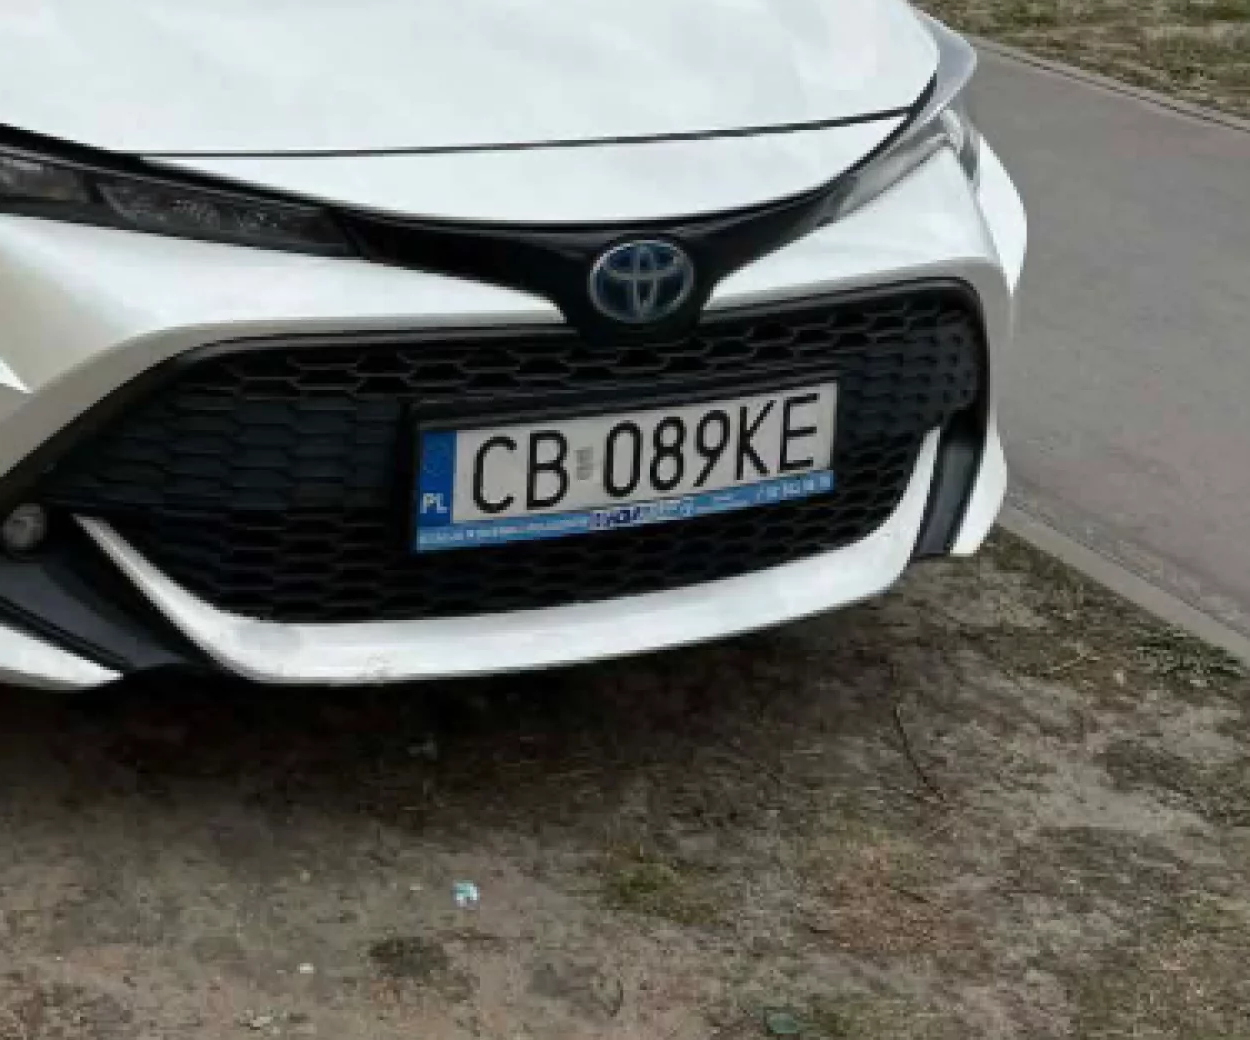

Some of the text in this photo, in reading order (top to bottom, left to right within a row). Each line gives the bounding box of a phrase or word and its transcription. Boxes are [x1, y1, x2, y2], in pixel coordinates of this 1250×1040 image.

[472, 392, 819, 514] CB 089KE
[422, 492, 447, 514] PL
